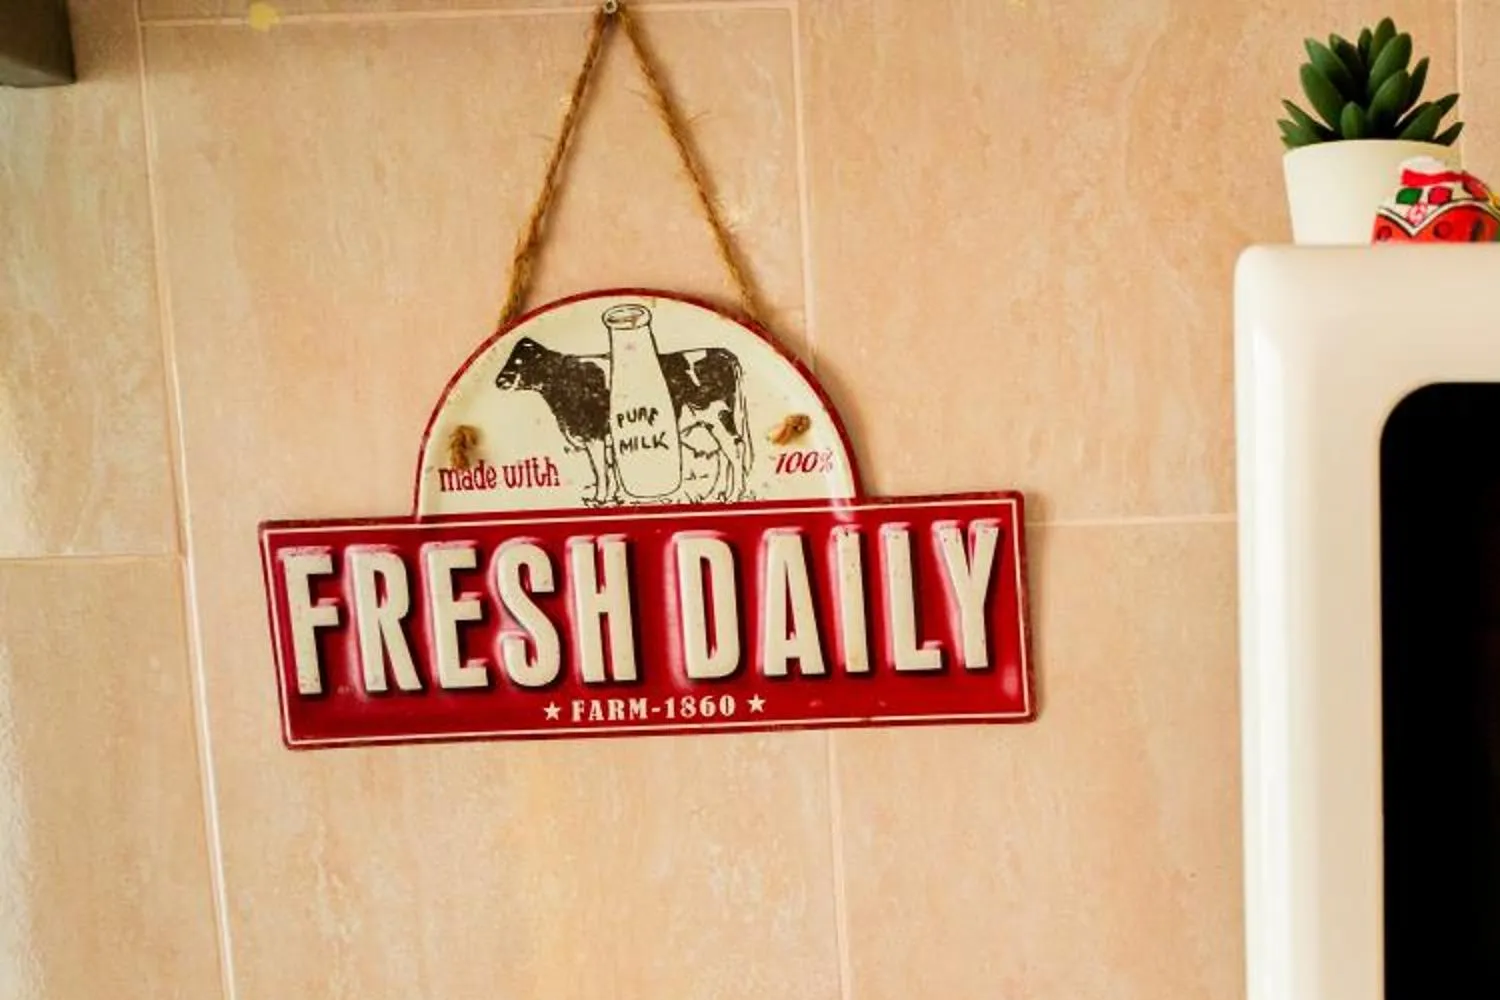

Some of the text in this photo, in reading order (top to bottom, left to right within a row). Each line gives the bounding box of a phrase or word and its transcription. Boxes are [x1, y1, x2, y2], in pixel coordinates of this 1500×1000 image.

[616, 407, 660, 429] PURE
[618, 431, 669, 456] MILK
[438, 456, 562, 493] made with
[774, 450, 835, 476] 100%
[277, 519, 1002, 697] FRESH DAILY
[570, 694, 737, 723] FARM-1860
